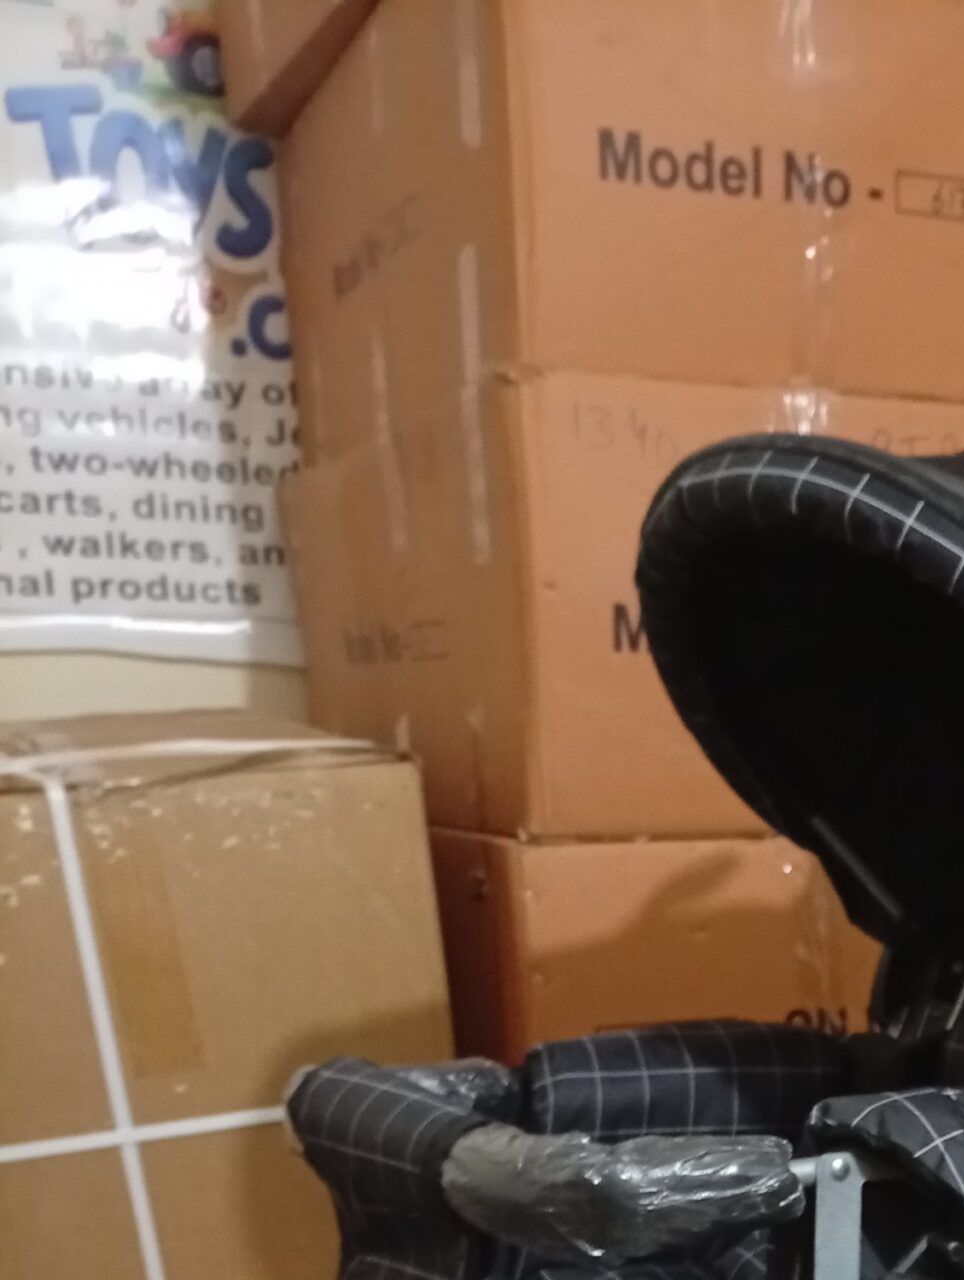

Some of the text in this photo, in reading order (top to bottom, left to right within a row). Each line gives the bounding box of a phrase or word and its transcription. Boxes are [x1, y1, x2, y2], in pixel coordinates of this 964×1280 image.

[597, 126, 764, 200] Model
[783, 149, 852, 207] No
[132, 493, 266, 533] dining
[41, 530, 223, 568] walkers,
[70, 575, 263, 606] products
